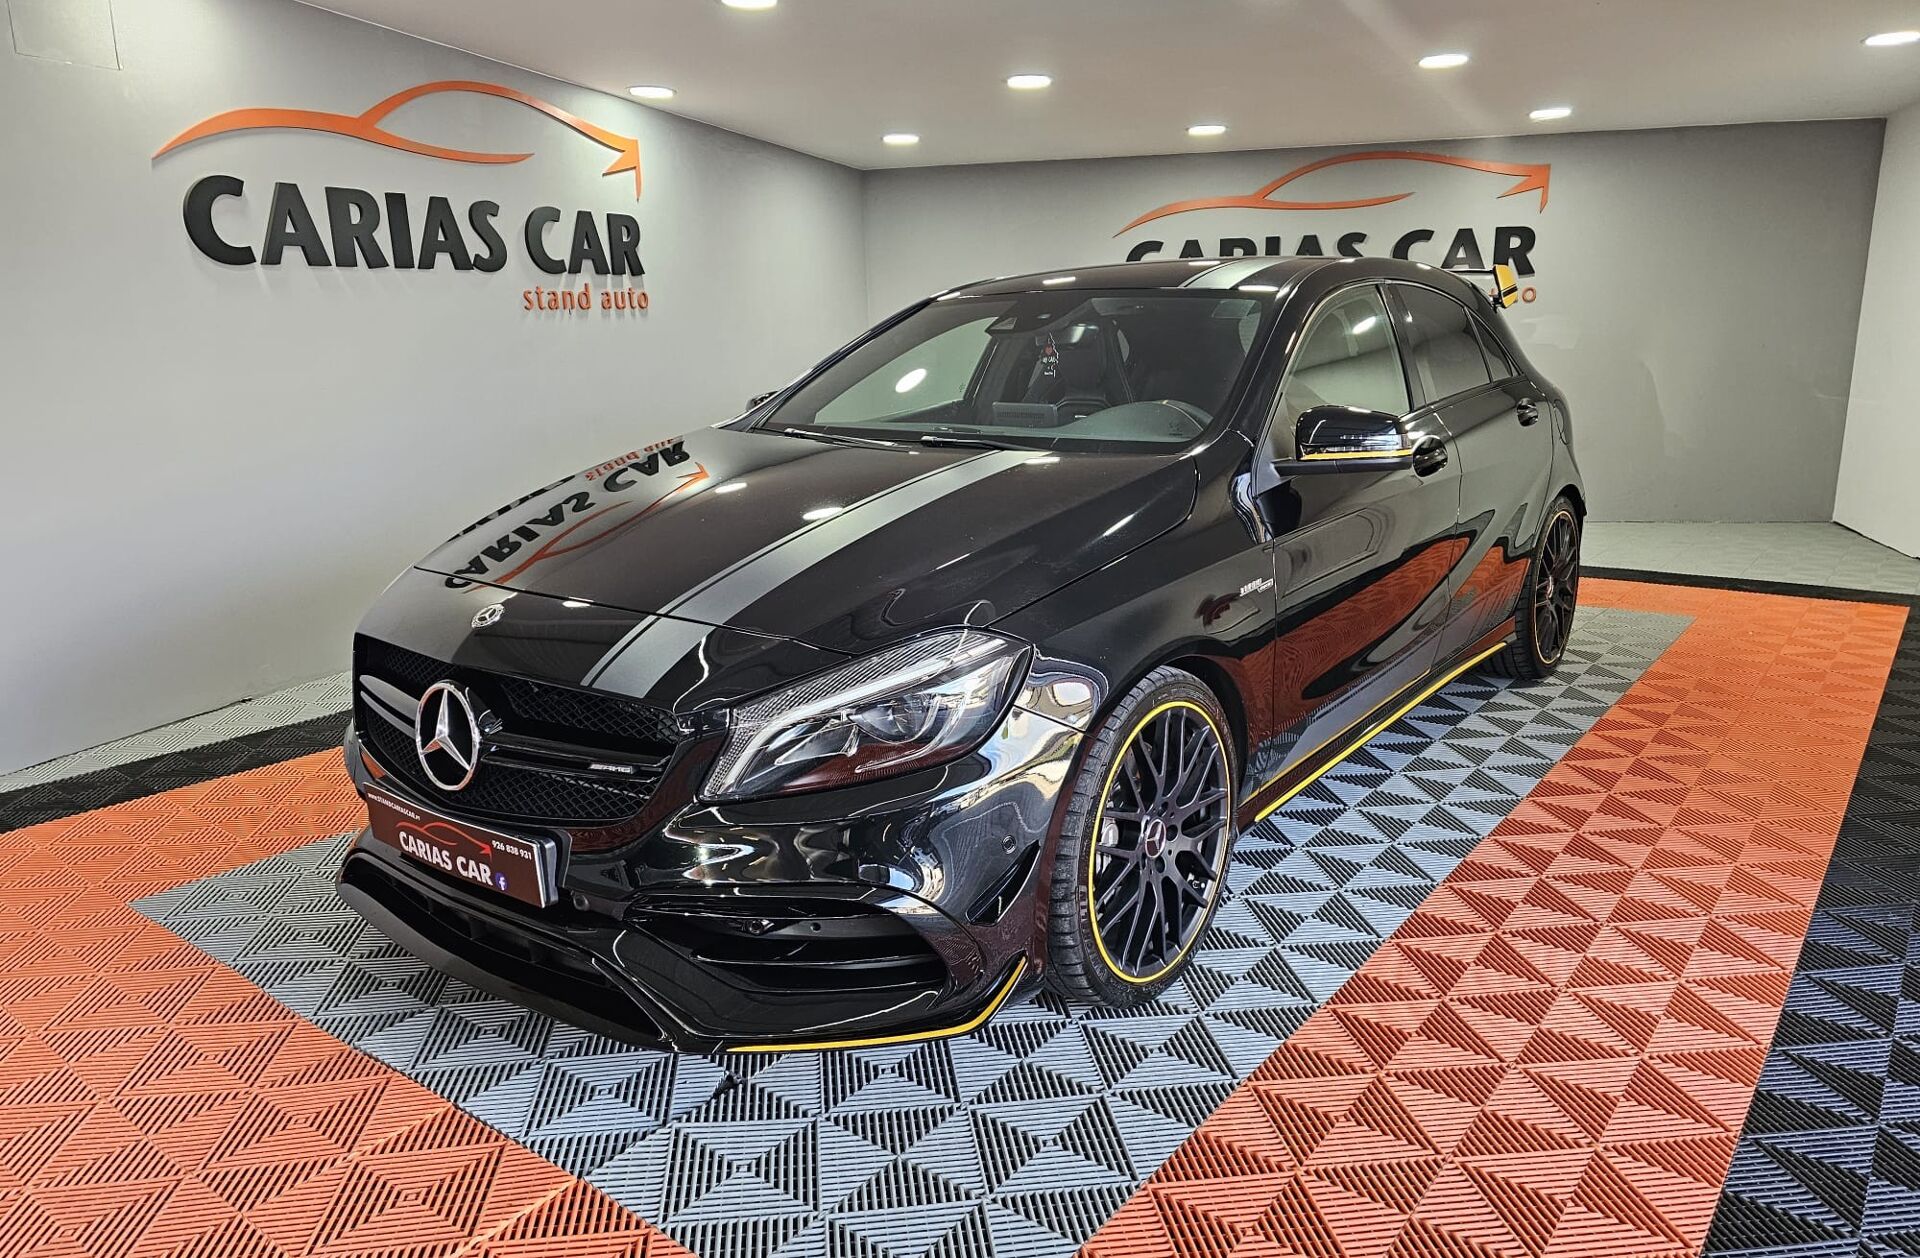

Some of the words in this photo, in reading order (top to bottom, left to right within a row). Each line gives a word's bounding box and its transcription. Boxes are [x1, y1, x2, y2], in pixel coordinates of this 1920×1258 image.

[183, 175, 508, 273] CARIAS
[524, 206, 645, 276] CAR
[522, 283, 591, 311] stand
[601, 289, 649, 311] auto
[398, 831, 453, 871] CARIAS
[456, 855, 494, 886] CAR
